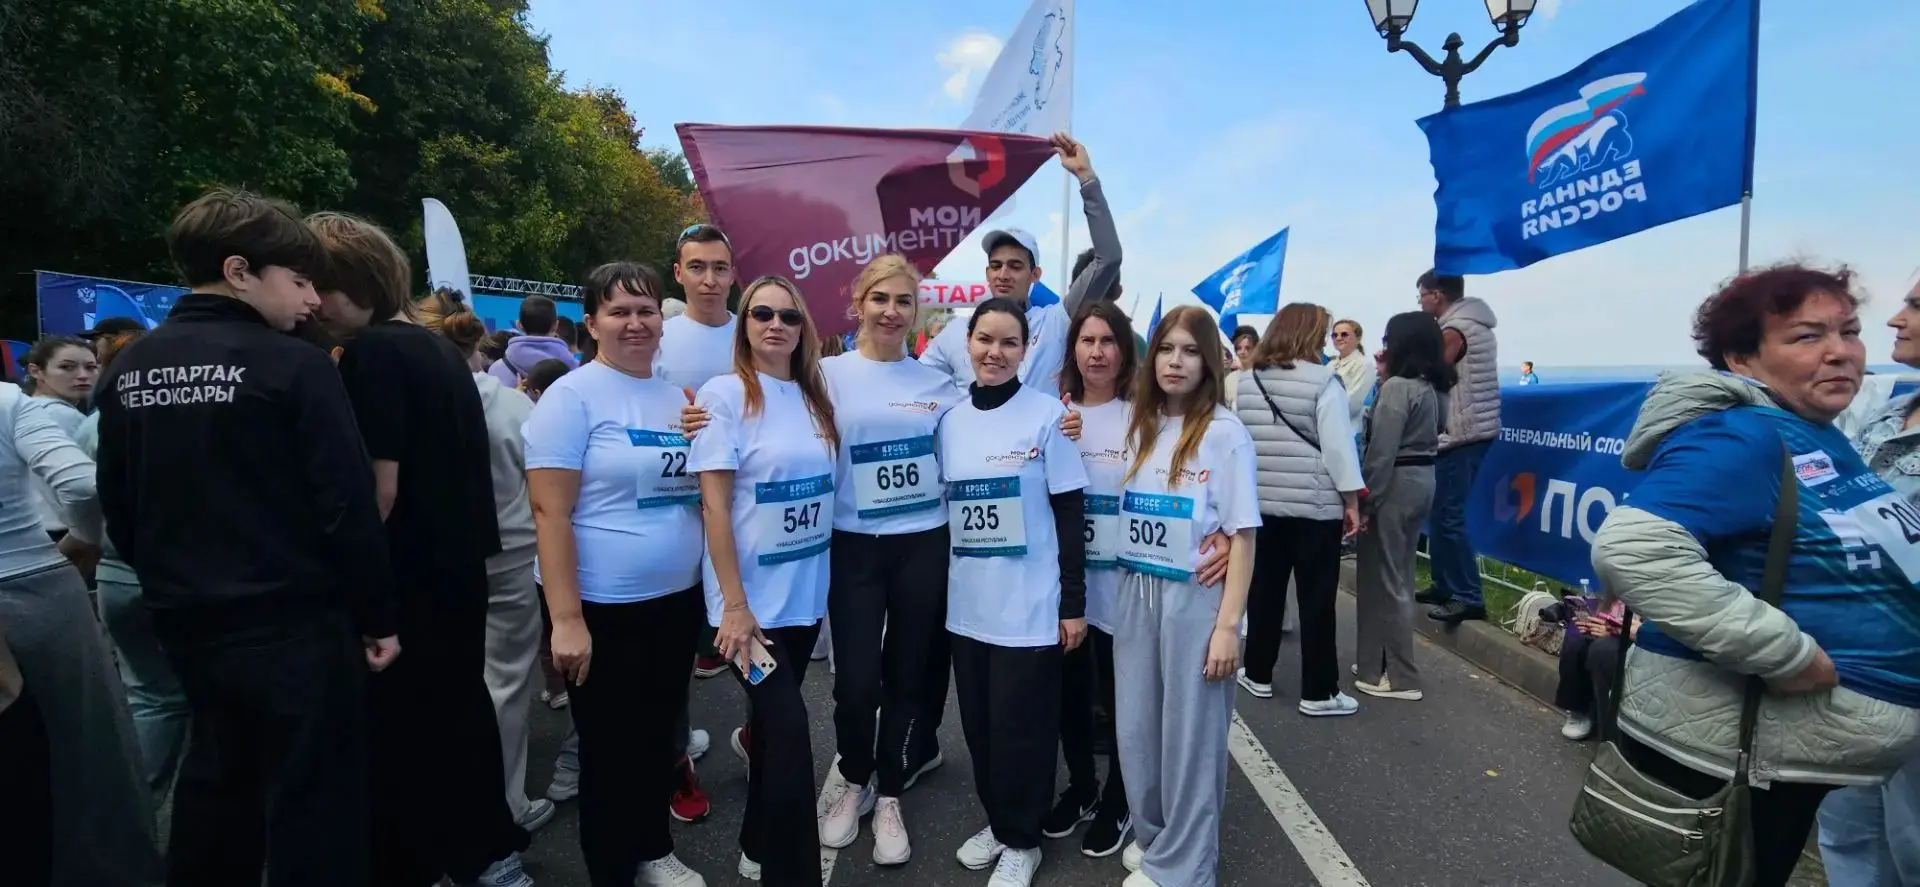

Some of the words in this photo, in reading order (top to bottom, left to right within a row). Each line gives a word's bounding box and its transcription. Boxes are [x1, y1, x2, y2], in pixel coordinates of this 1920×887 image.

[117, 370, 141, 392] СШ
[147, 364, 247, 386] СПАРТАК
[120, 385, 236, 409] ЧЕБОКСАРЫ
[1499, 427, 1592, 452] ГЕНЕРАЛЬНЫЙ
[1594, 436, 1625, 456] СПО
[876, 462, 920, 491] 656
[783, 501, 822, 534] 547
[961, 504, 1000, 531] 235
[1540, 478, 1630, 548] ПО
[1129, 518, 1168, 548] 502
